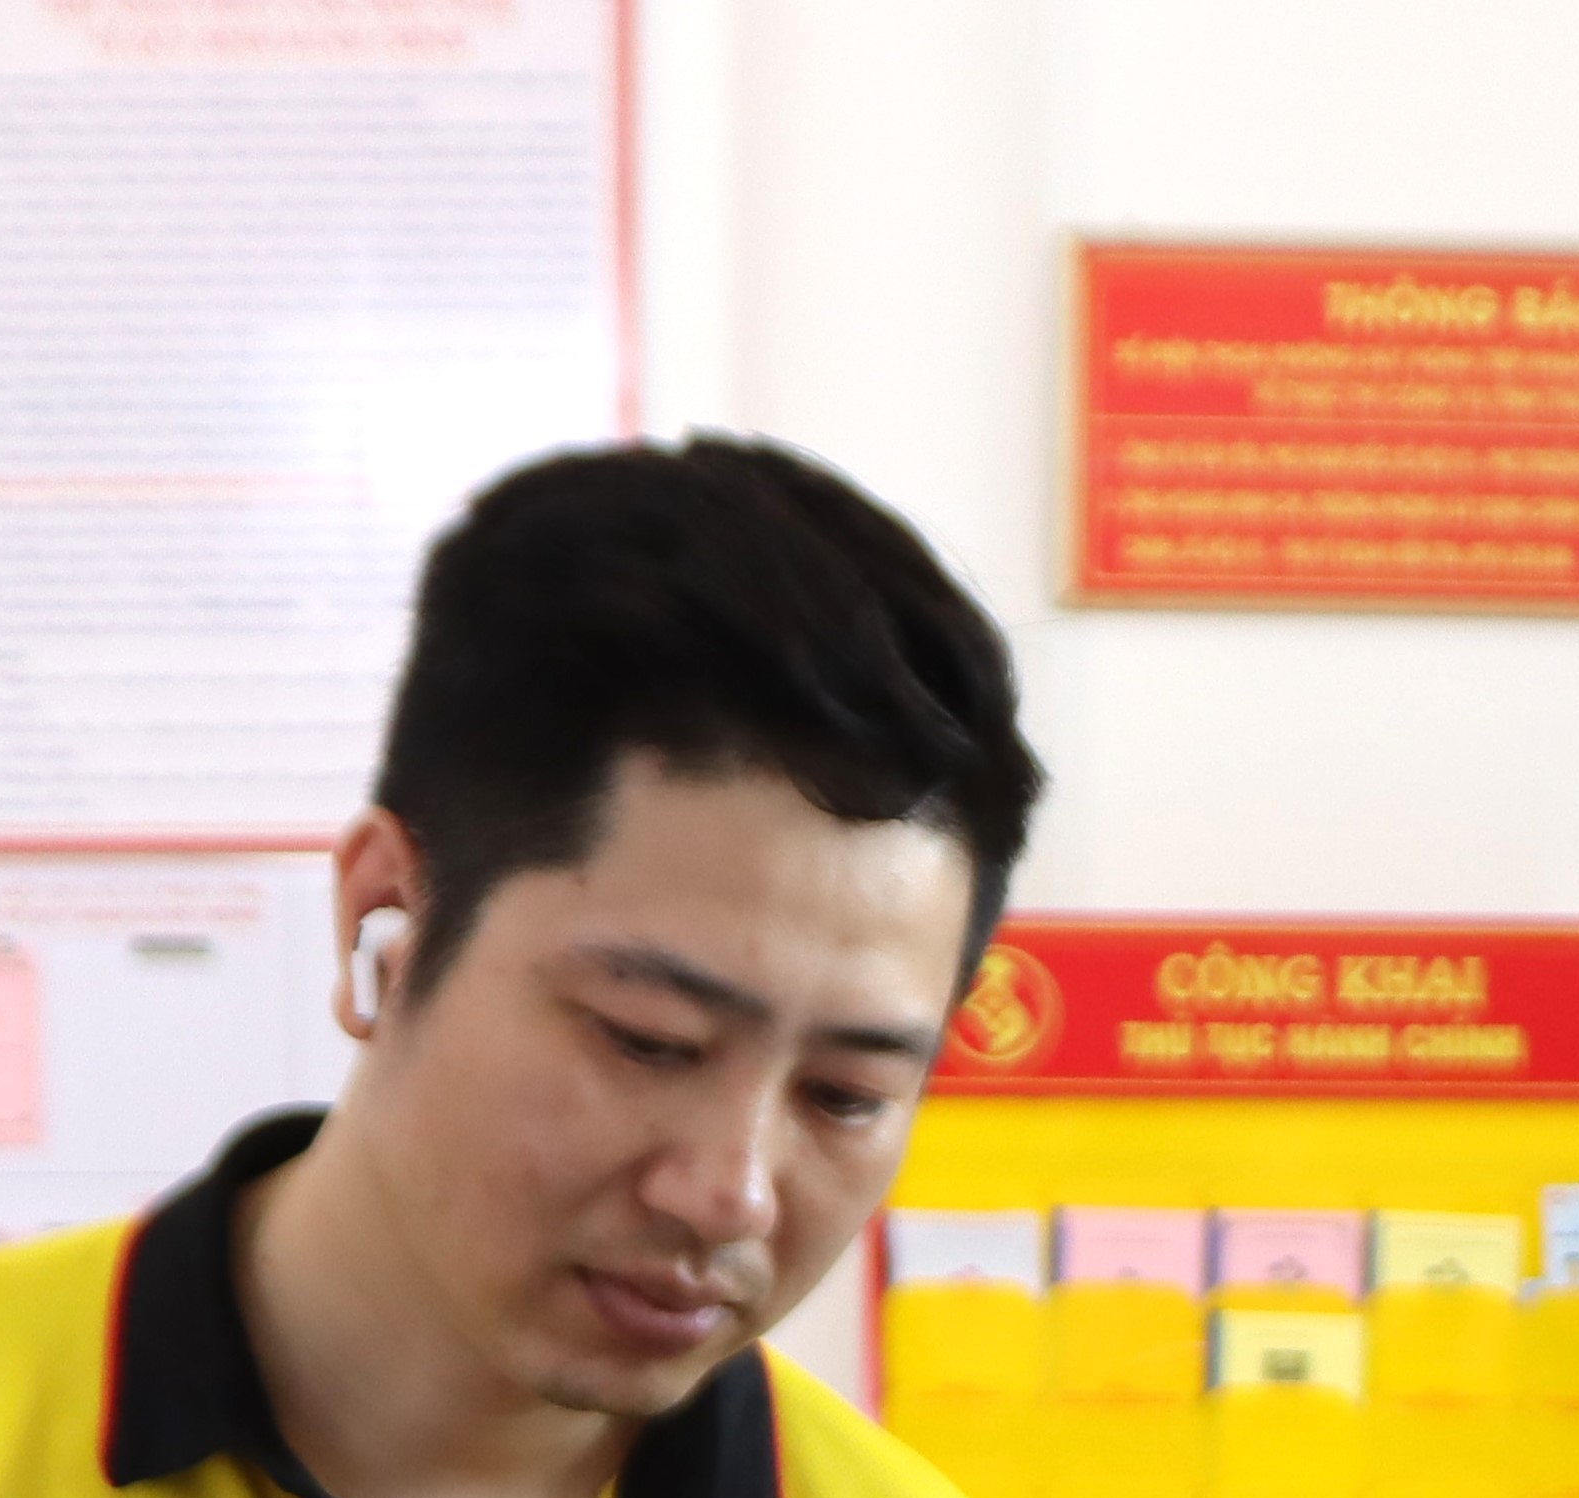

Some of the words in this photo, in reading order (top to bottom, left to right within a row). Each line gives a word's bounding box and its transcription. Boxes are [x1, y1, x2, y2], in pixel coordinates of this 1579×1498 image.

[1324, 273, 1500, 326] THÔNG
[1157, 940, 1324, 1004] CÔNG
[1336, 954, 1489, 1005] KHAI
